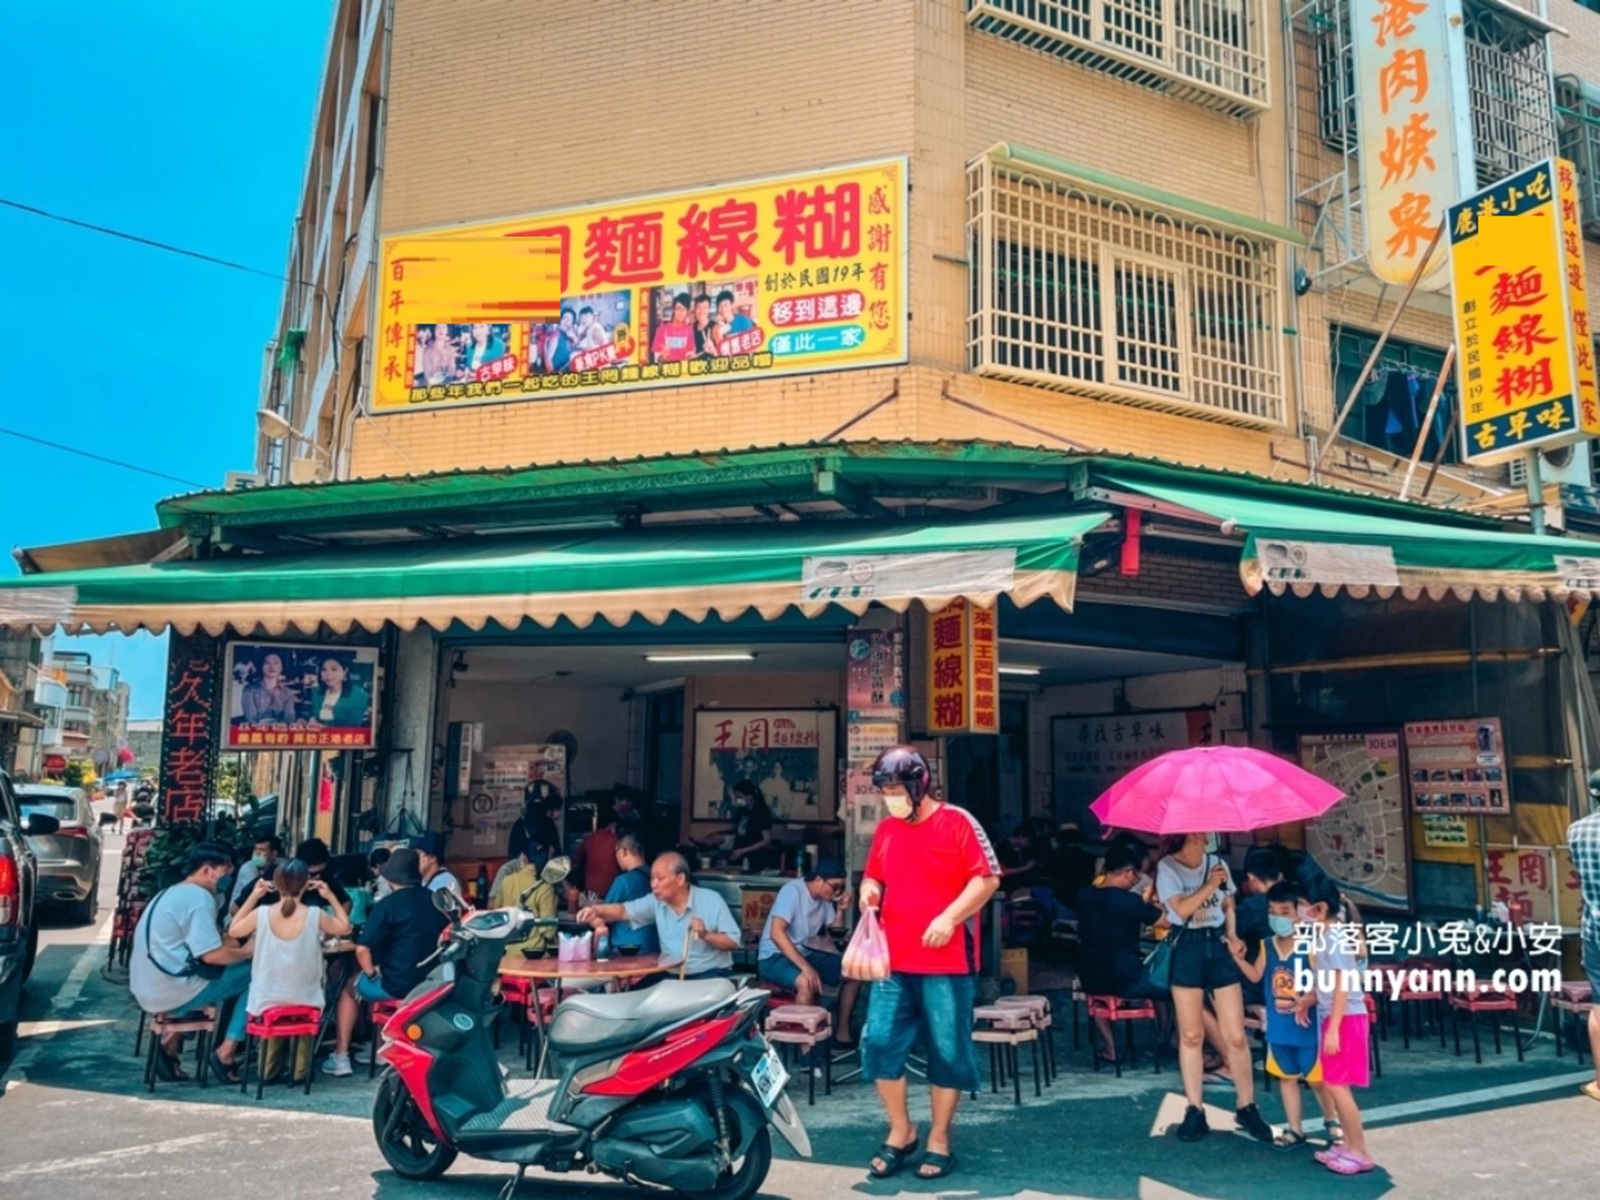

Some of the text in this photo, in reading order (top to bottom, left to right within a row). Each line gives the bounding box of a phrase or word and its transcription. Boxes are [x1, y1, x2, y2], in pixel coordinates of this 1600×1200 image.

[503, 181, 861, 293] 麵線糊
[867, 185, 892, 331] 感謝有您
[1558, 166, 1584, 291] 移到這邊
[383, 257, 405, 382] 百年傳承
[770, 327, 863, 355] 僅此一家
[771, 292, 863, 325] 移到這邊
[1473, 402, 1571, 449] 古早味
